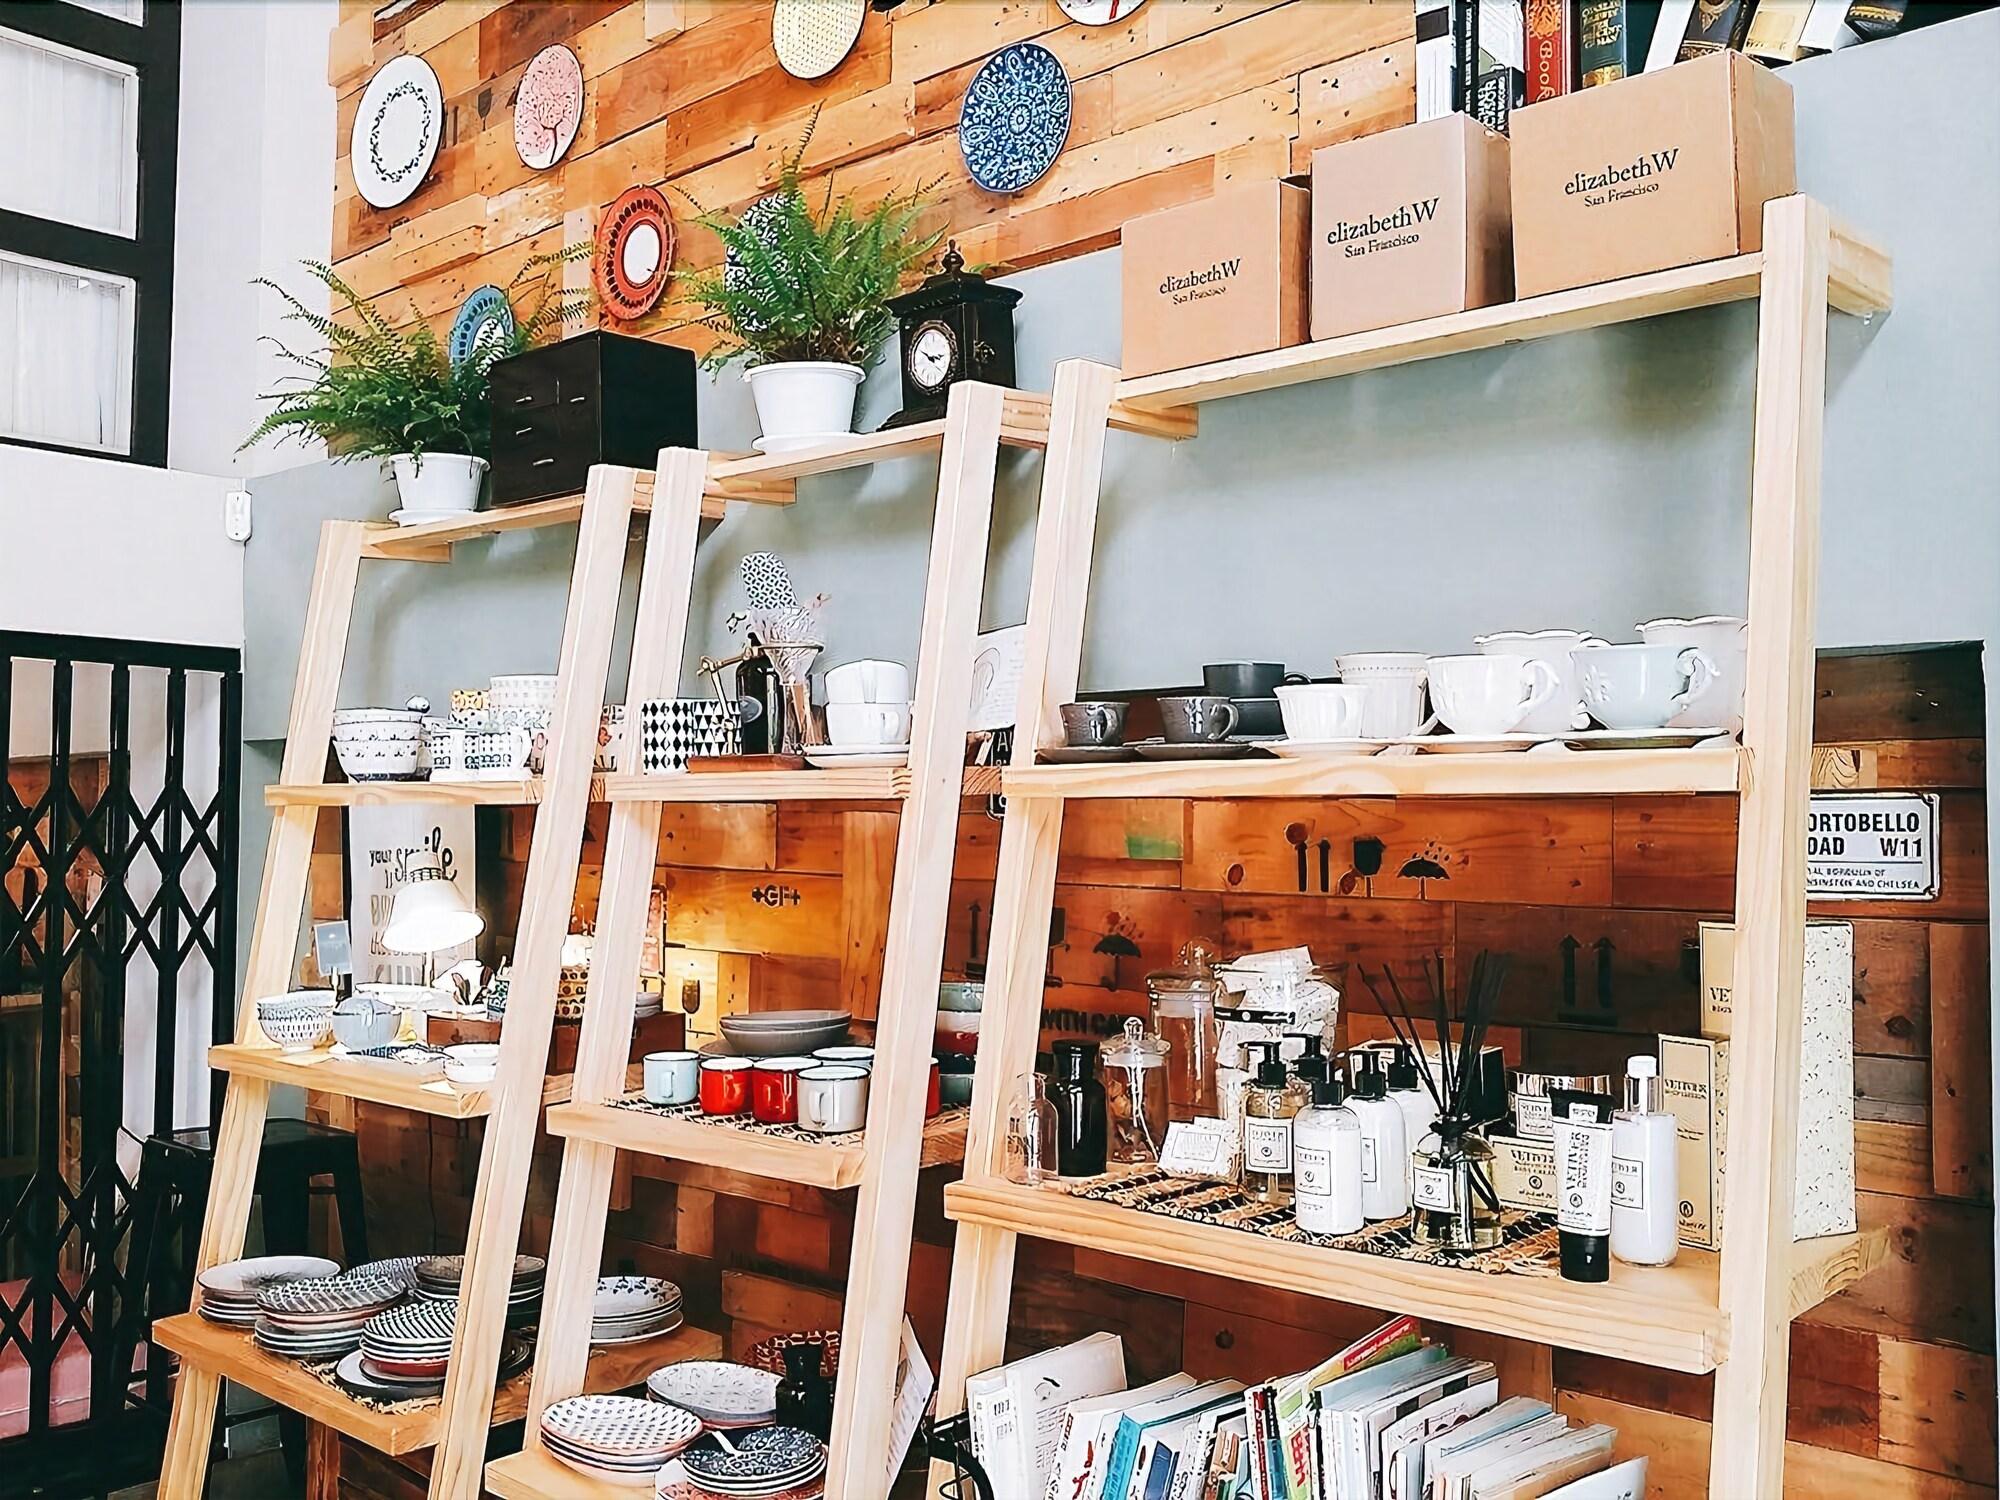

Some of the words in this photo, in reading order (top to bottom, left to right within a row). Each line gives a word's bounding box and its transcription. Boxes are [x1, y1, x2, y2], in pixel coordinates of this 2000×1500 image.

[1808, 812, 1920, 832] ORTOBELLO
[1807, 836, 1845, 855] OAD
[1879, 837, 1922, 857] W11
[1855, 879, 1875, 888] AND
